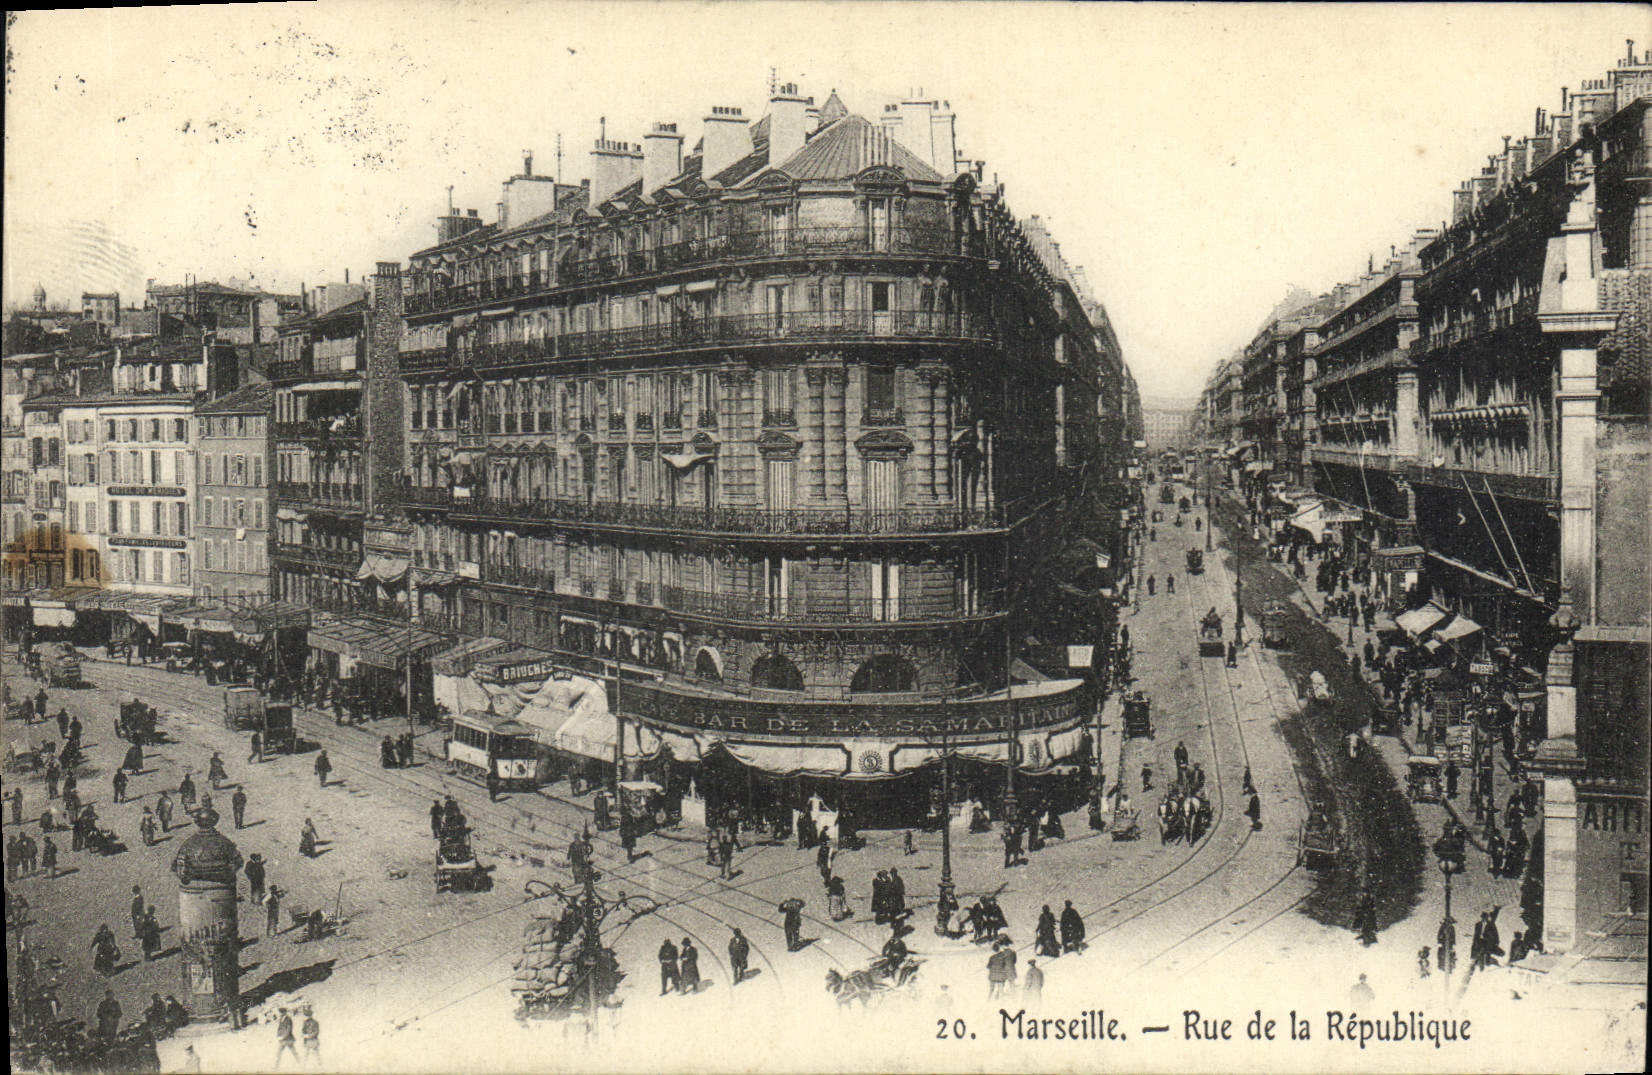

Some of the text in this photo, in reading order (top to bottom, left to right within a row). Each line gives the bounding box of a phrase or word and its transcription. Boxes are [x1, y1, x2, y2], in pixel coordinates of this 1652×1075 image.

[694, 711, 748, 729] BAR
[767, 718, 809, 732] DE
[832, 719, 878, 732] LA
[896, 703, 1077, 733] SAMARITAIN
